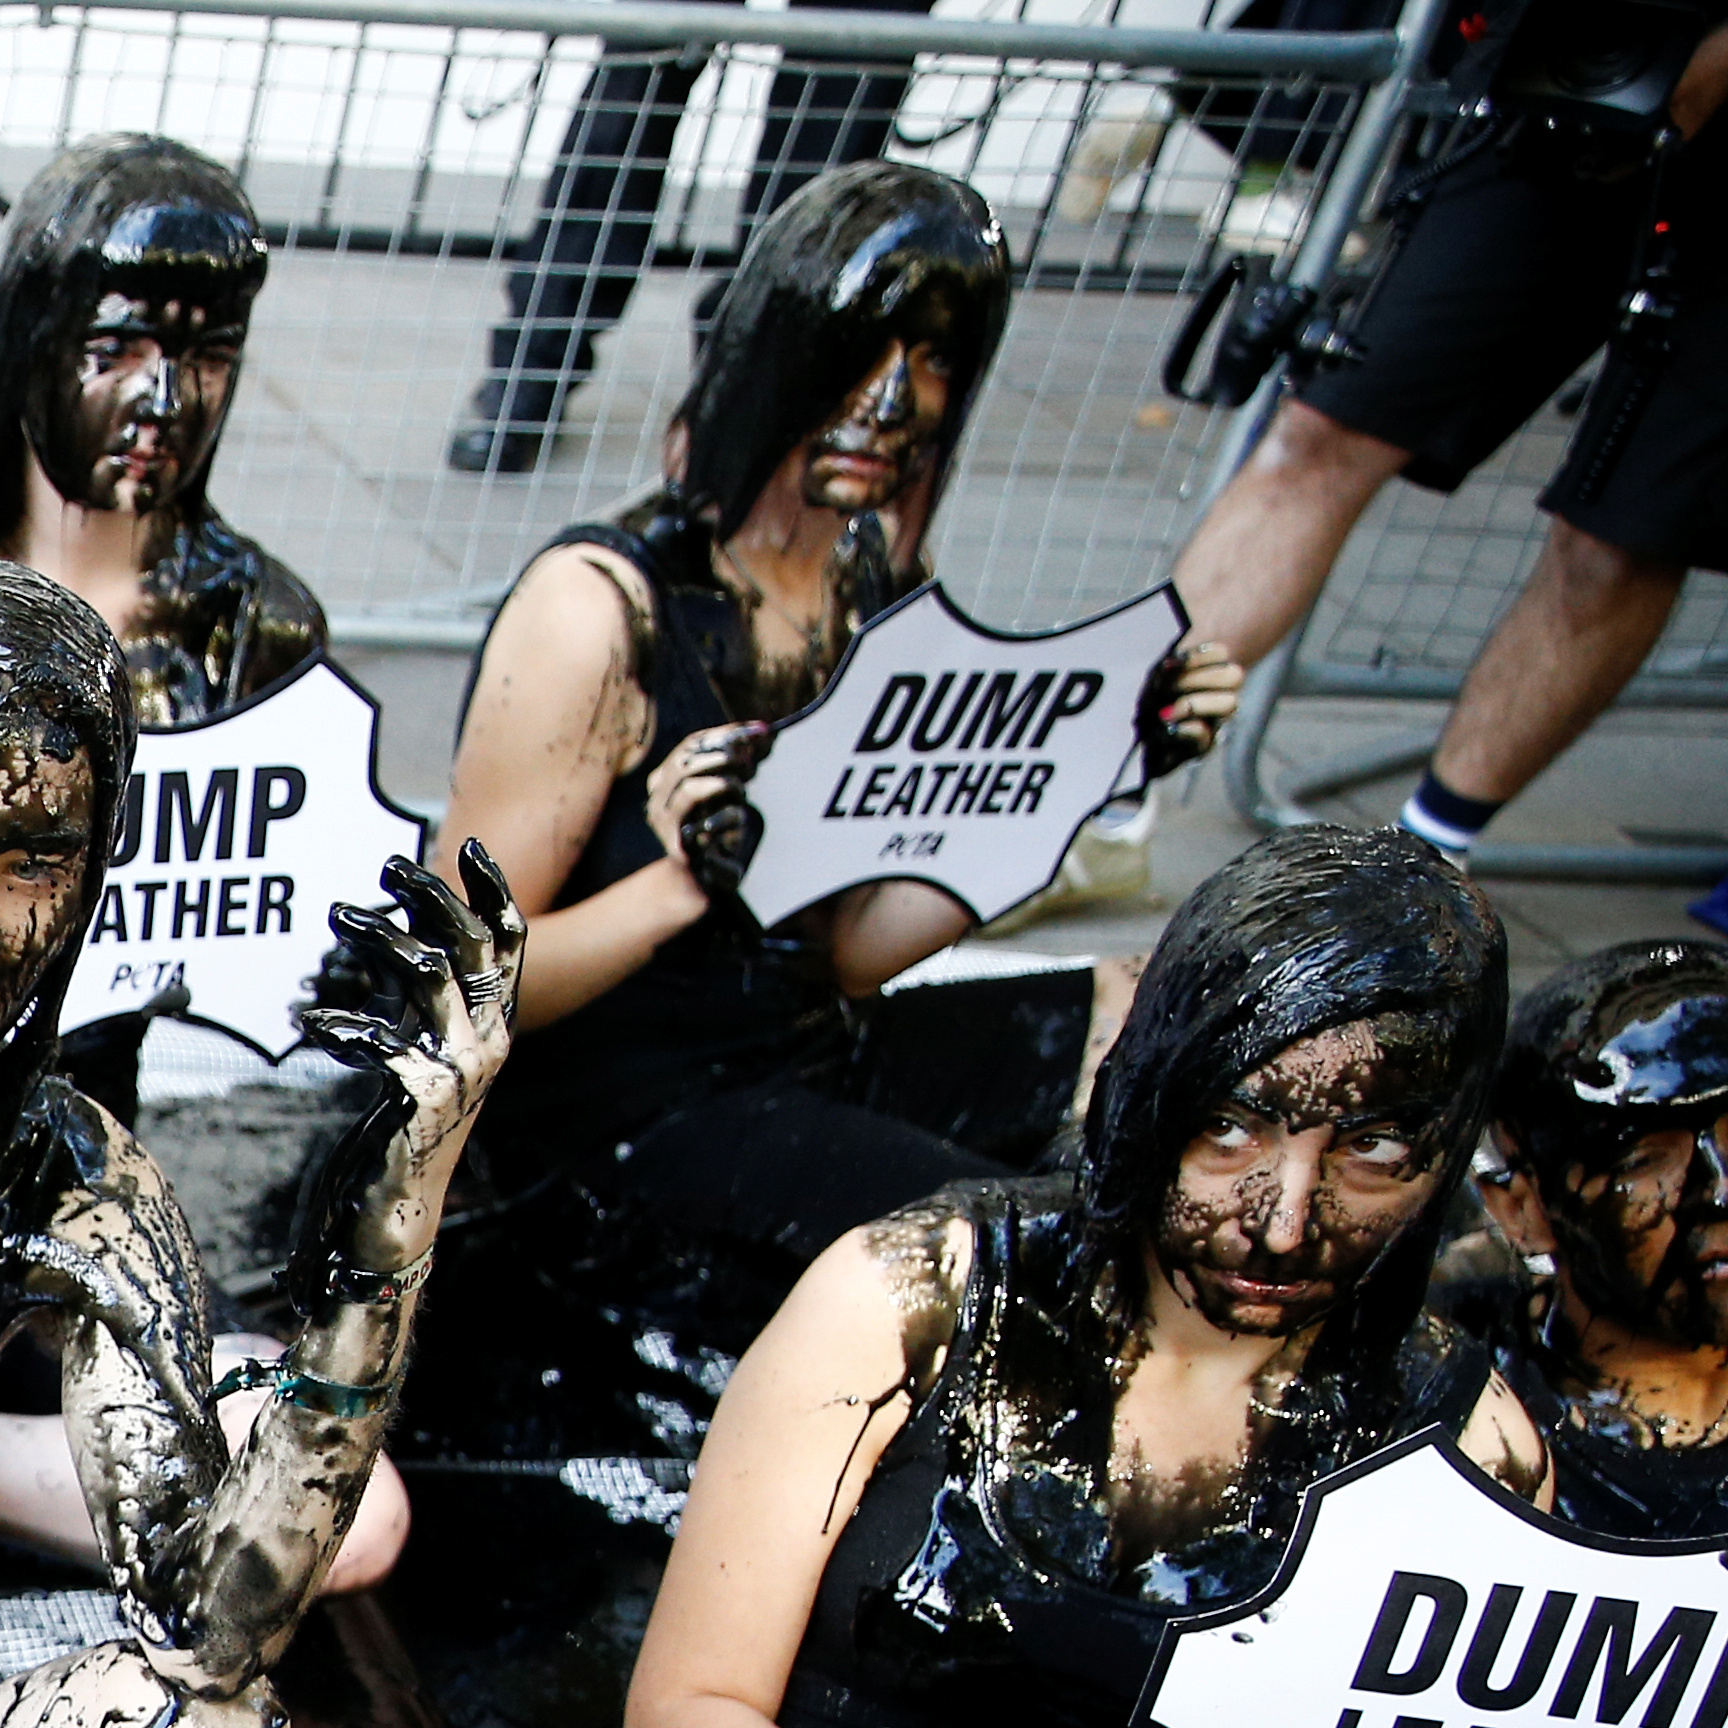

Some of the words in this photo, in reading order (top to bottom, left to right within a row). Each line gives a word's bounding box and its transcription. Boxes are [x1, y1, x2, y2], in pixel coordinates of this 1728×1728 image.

[852, 668, 1106, 755] DUMP
[108, 766, 308, 867] UMP
[821, 760, 1055, 821] LEATHER
[89, 874, 296, 945] ATHER
